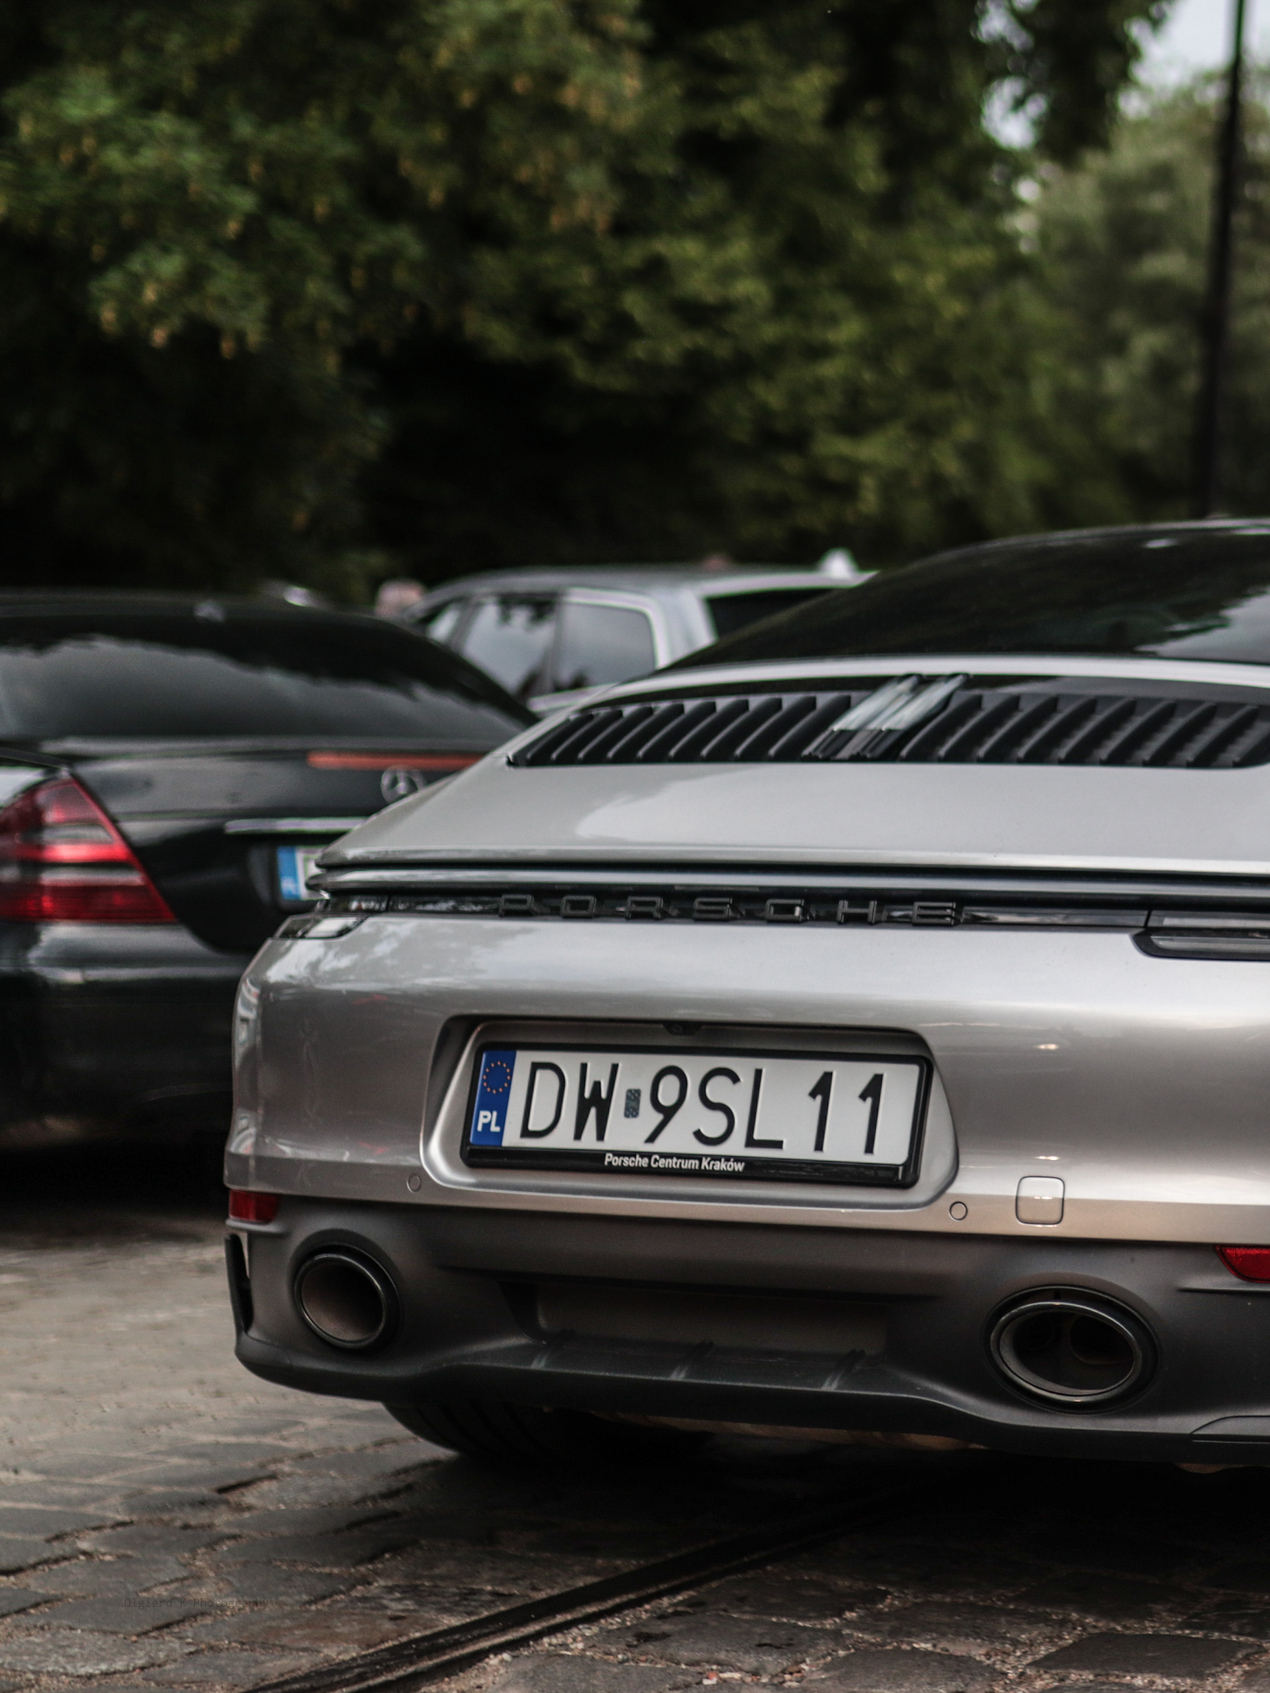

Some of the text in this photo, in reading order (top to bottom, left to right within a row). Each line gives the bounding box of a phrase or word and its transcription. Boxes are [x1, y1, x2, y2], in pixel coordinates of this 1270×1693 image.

[500, 894, 957, 927] PORSCHE
[520, 1061, 620, 1142] DW
[477, 1110, 501, 1132] PL
[604, 1152, 745, 1172] Porsche Centrum Kraków
